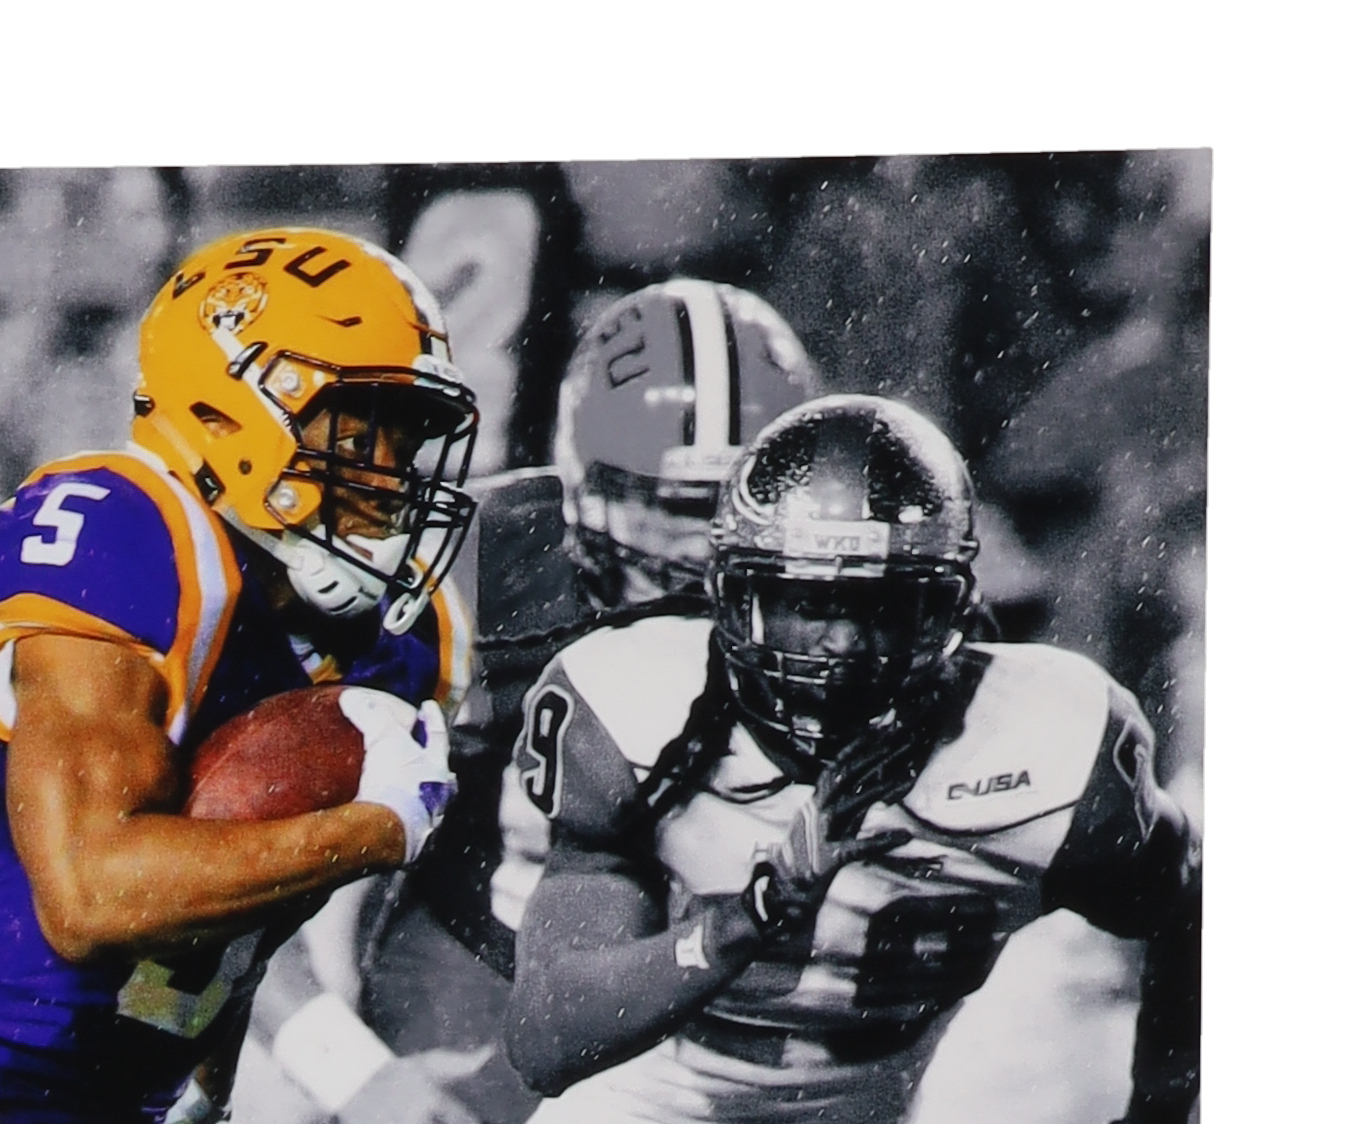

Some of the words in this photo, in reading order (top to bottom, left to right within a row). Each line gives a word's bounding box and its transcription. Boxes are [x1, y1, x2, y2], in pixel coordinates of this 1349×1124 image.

[172, 237, 351, 299] LSU
[20, 482, 111, 567] 5
[522, 684, 575, 818] 9
